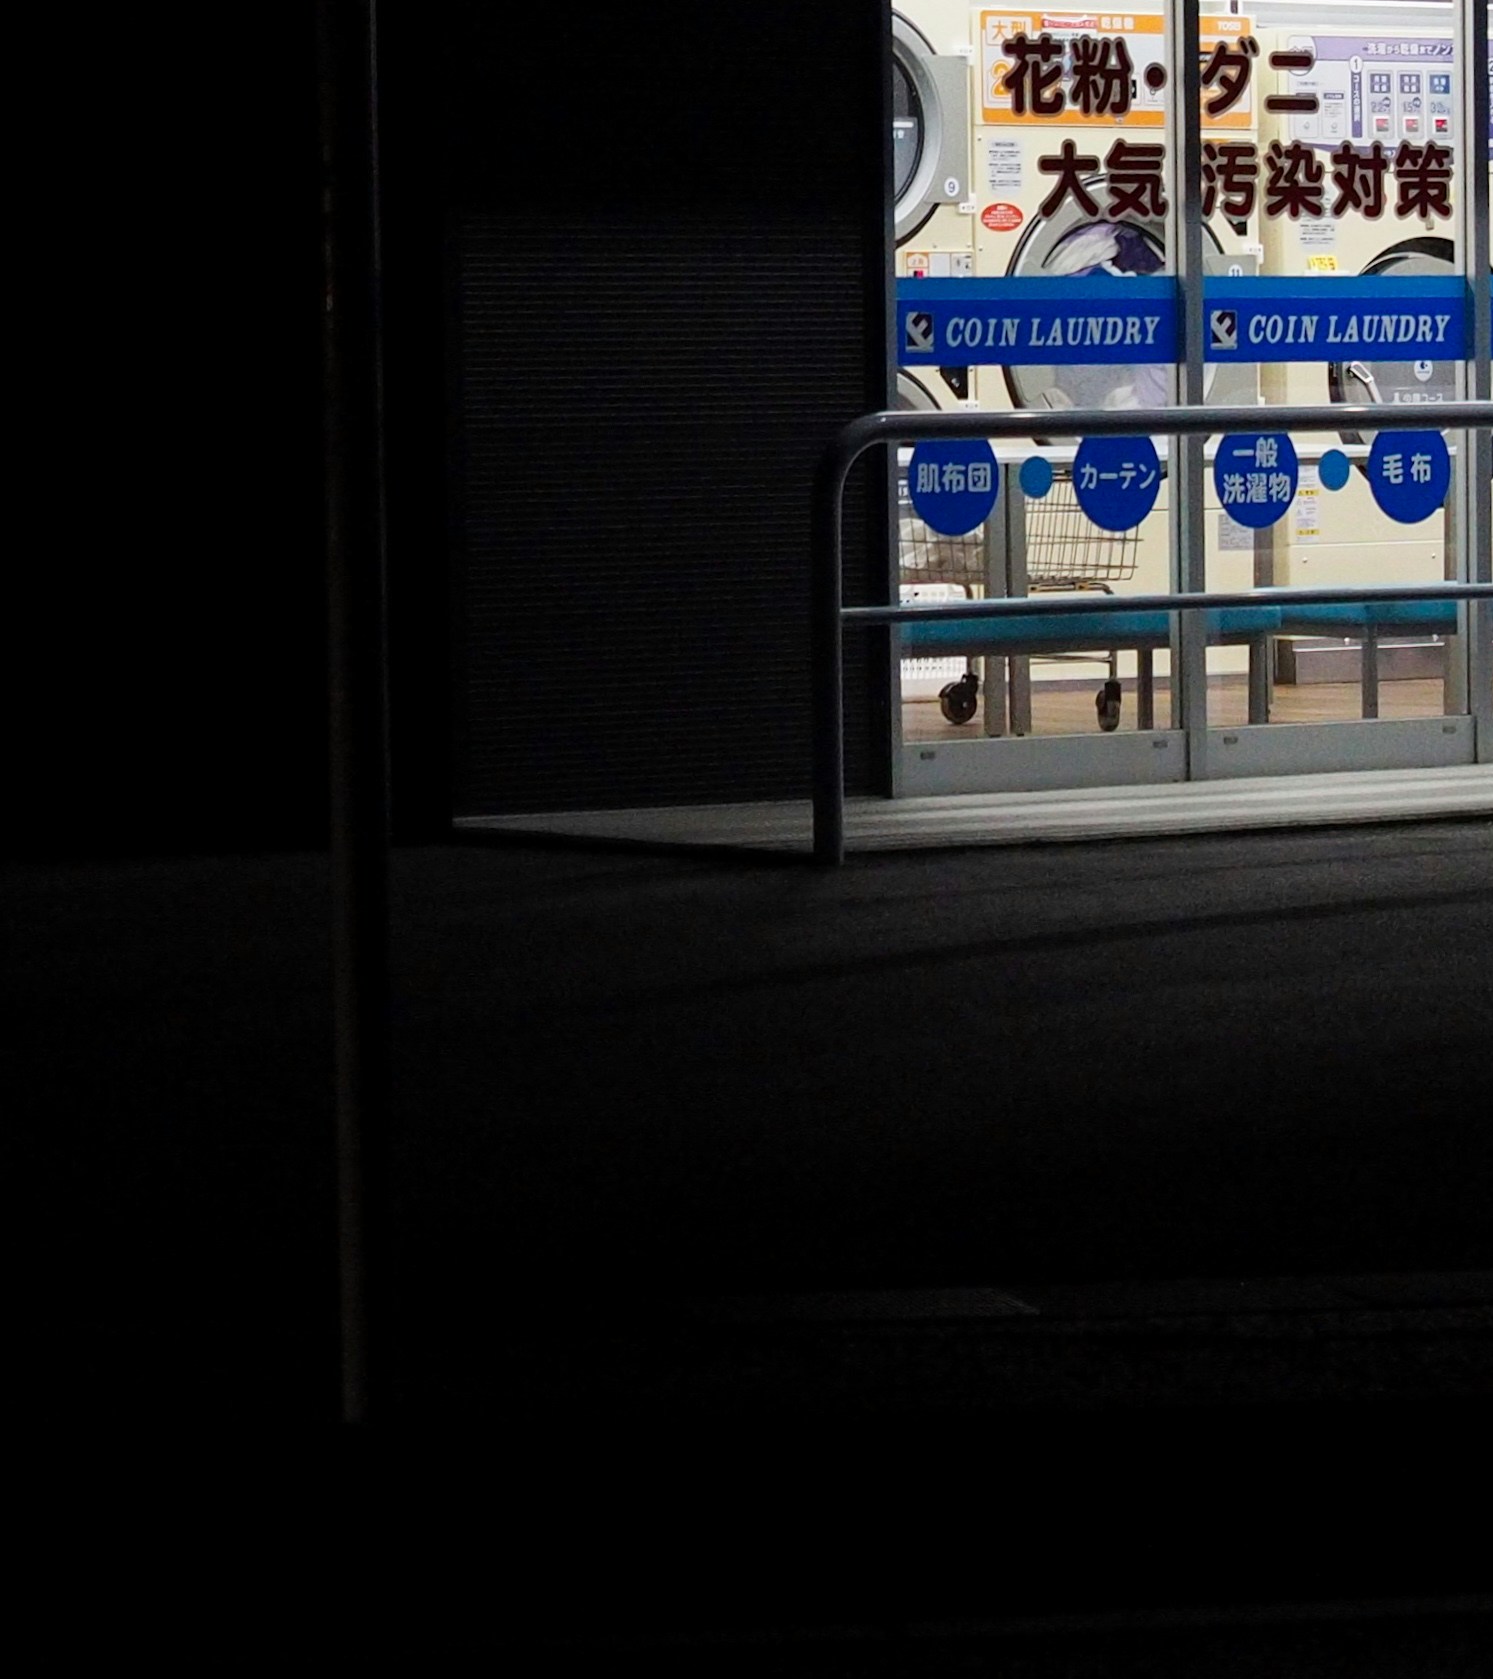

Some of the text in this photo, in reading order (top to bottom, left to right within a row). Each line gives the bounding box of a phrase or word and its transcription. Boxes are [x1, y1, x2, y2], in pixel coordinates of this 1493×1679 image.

[947, 181, 956, 194] 9
[1037, 138, 1454, 221] 大気汚染対策
[945, 315, 1161, 348] COIN LAUNDRY
[1248, 313, 1452, 344] COIN LAUNDRY
[1232, 436, 1279, 468] 一般
[916, 462, 993, 494] 肌布団
[1080, 461, 1157, 491] カーテン
[1382, 452, 1433, 485] 毛布
[1222, 473, 1292, 505] 洗濯物
